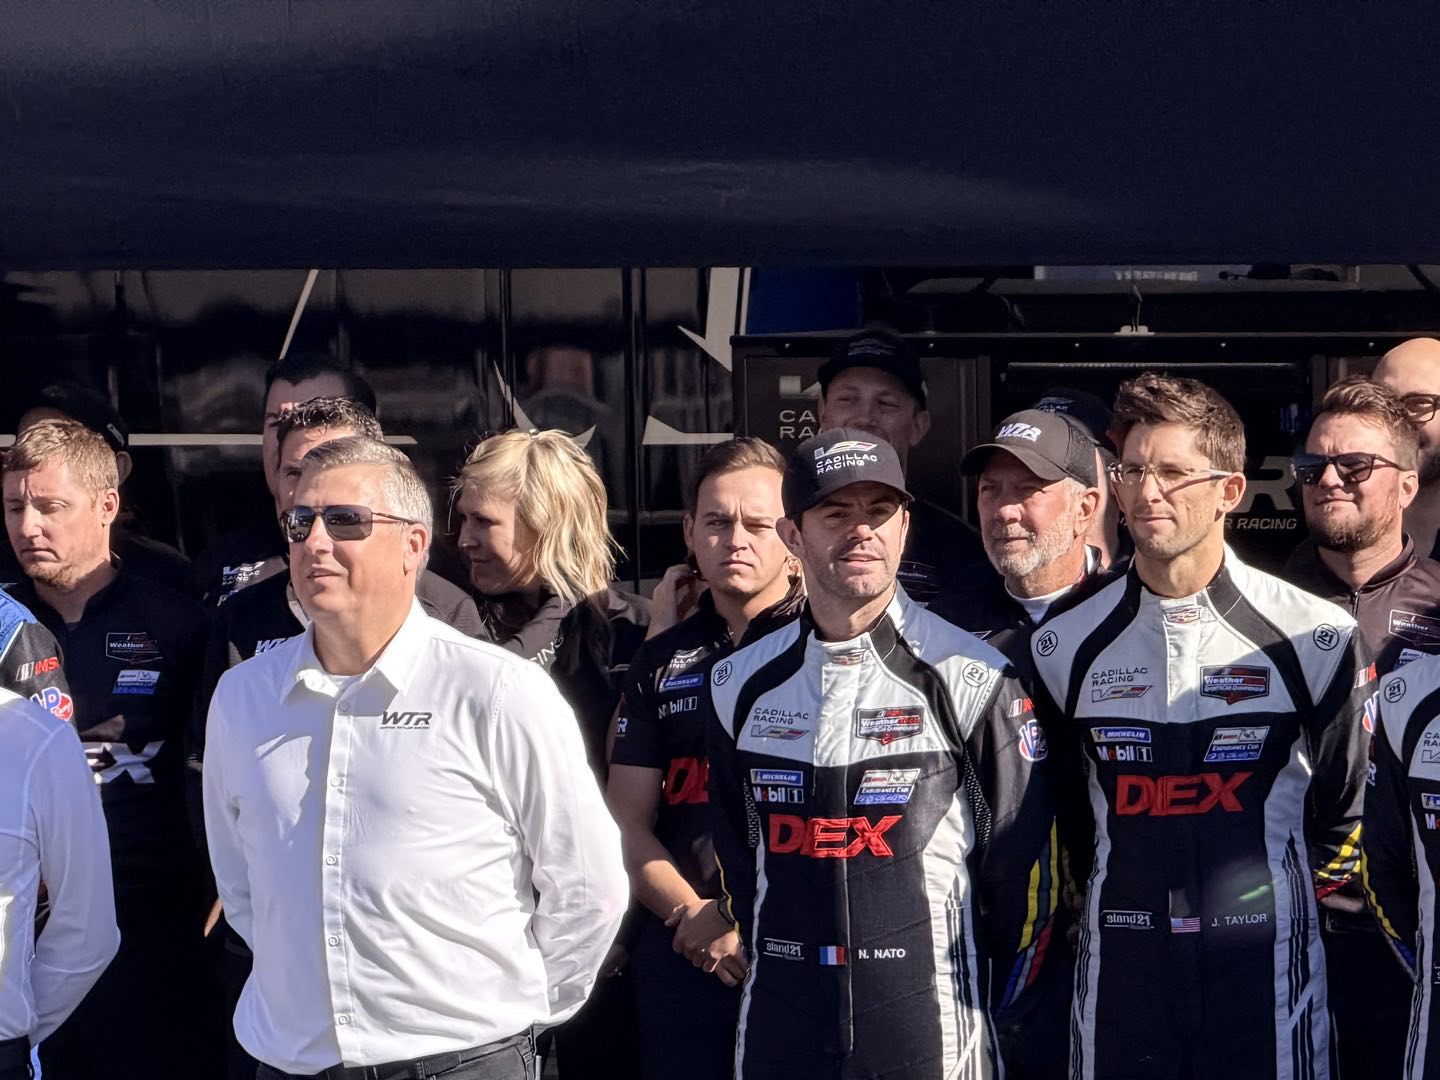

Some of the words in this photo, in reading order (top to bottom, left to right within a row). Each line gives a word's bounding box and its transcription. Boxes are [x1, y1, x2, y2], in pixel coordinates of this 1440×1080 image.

[816, 452, 878, 468] CADILLAC
[817, 460, 865, 476] RACING
[1236, 517, 1297, 530] RACING
[1092, 667, 1148, 679] CADILLAC
[1092, 674, 1135, 687] RACING
[381, 711, 433, 727] WTR
[753, 715, 794, 725] RACING
[754, 708, 809, 720] CADILLAC
[1106, 730, 1146, 739] MICHELIN
[1098, 745, 1134, 761] Mobil
[760, 772, 798, 782] MICHELIN
[752, 787, 786, 803] Mobil
[1116, 772, 1253, 816] DEX
[769, 813, 903, 858] DEX
[1211, 917, 1221, 928] J.
[1224, 914, 1268, 926] TAYLOR
[858, 948, 870, 959] N.
[874, 948, 906, 959] NATO
